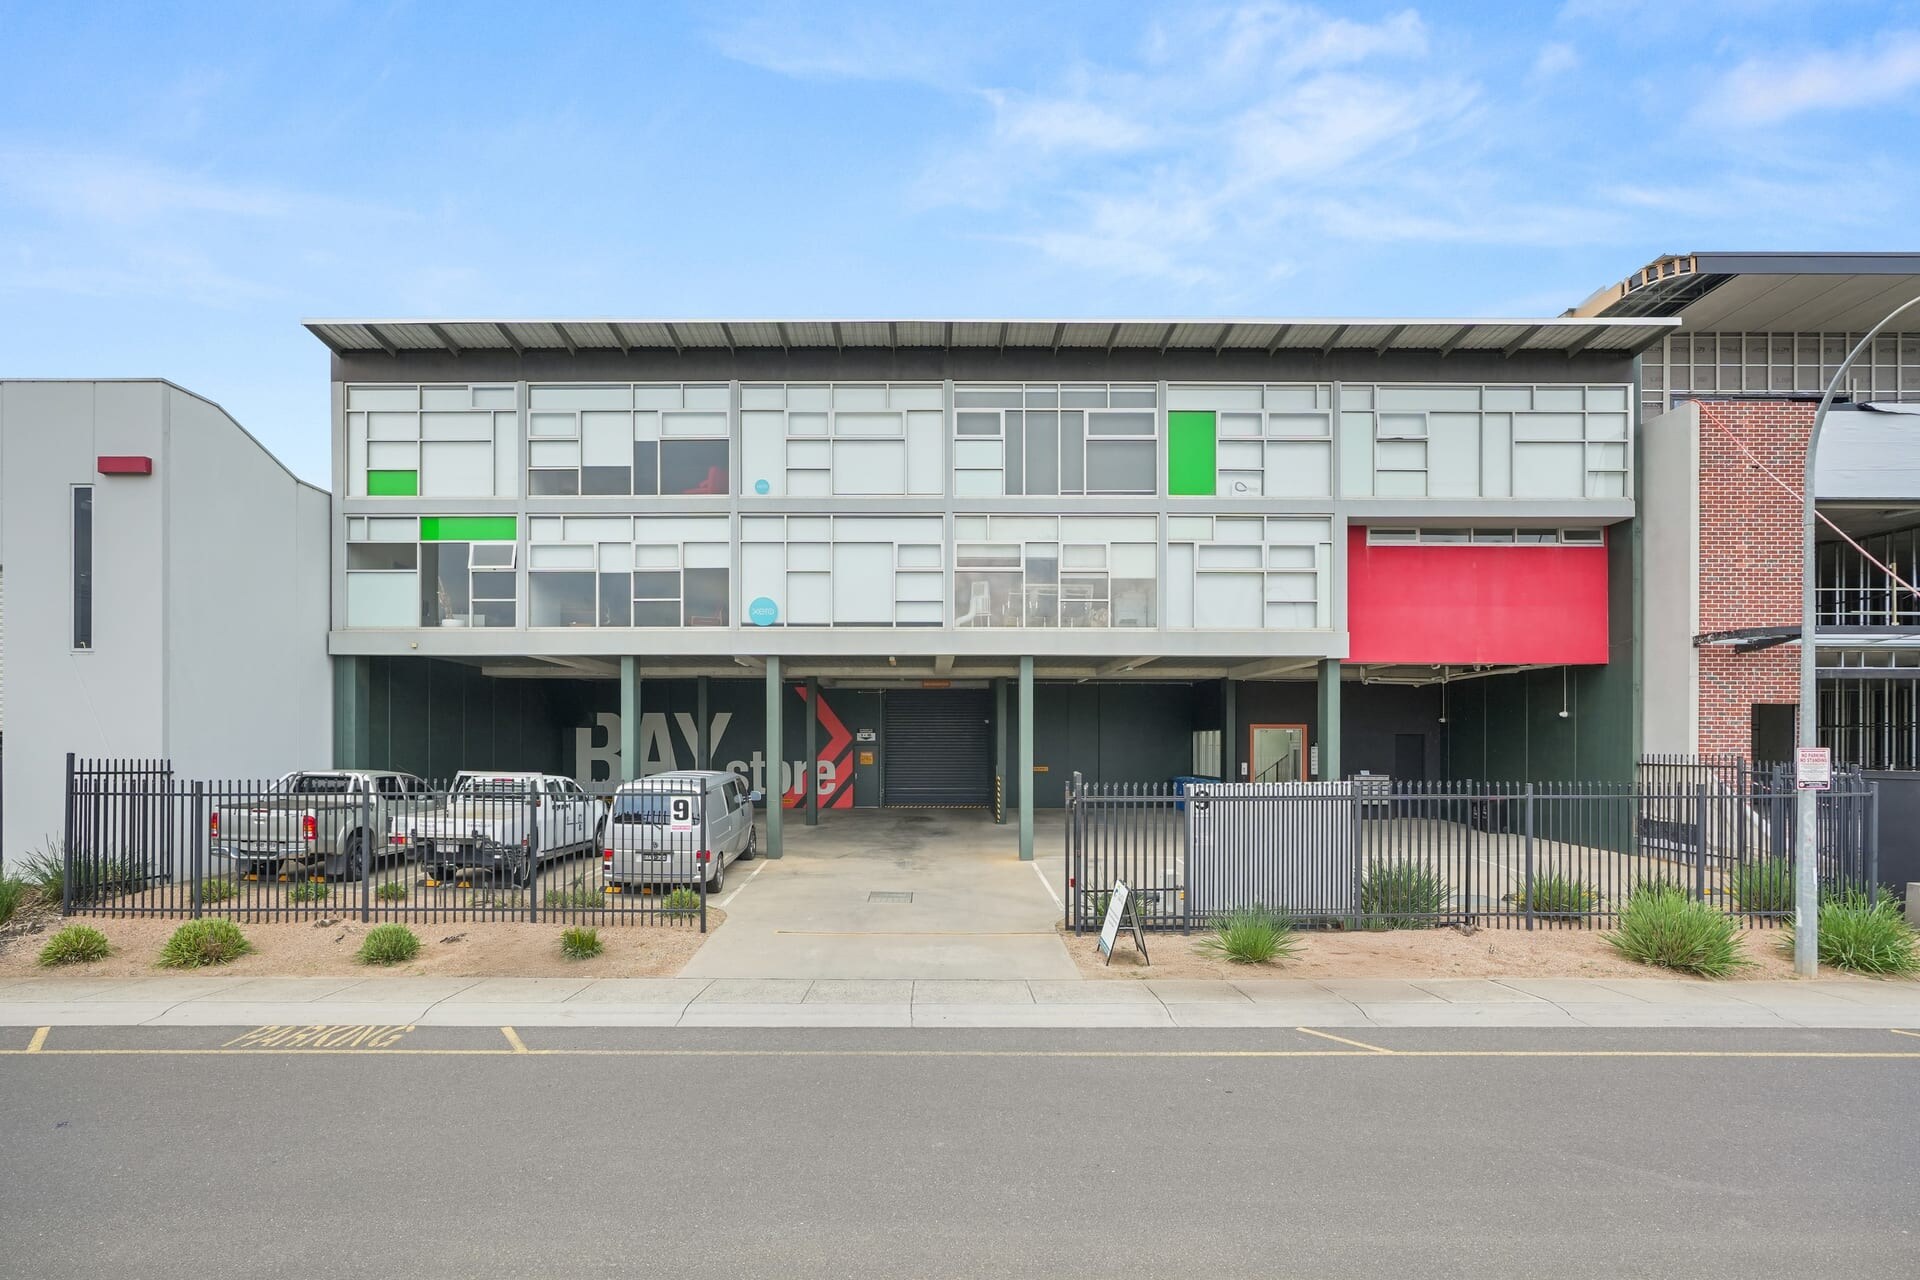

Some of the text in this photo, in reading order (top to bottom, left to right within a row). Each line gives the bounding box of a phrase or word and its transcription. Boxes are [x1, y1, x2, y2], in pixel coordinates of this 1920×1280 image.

[576, 712, 733, 795] BAY
[673, 799, 690, 821] 9
[222, 1025, 416, 1047] PARKING
